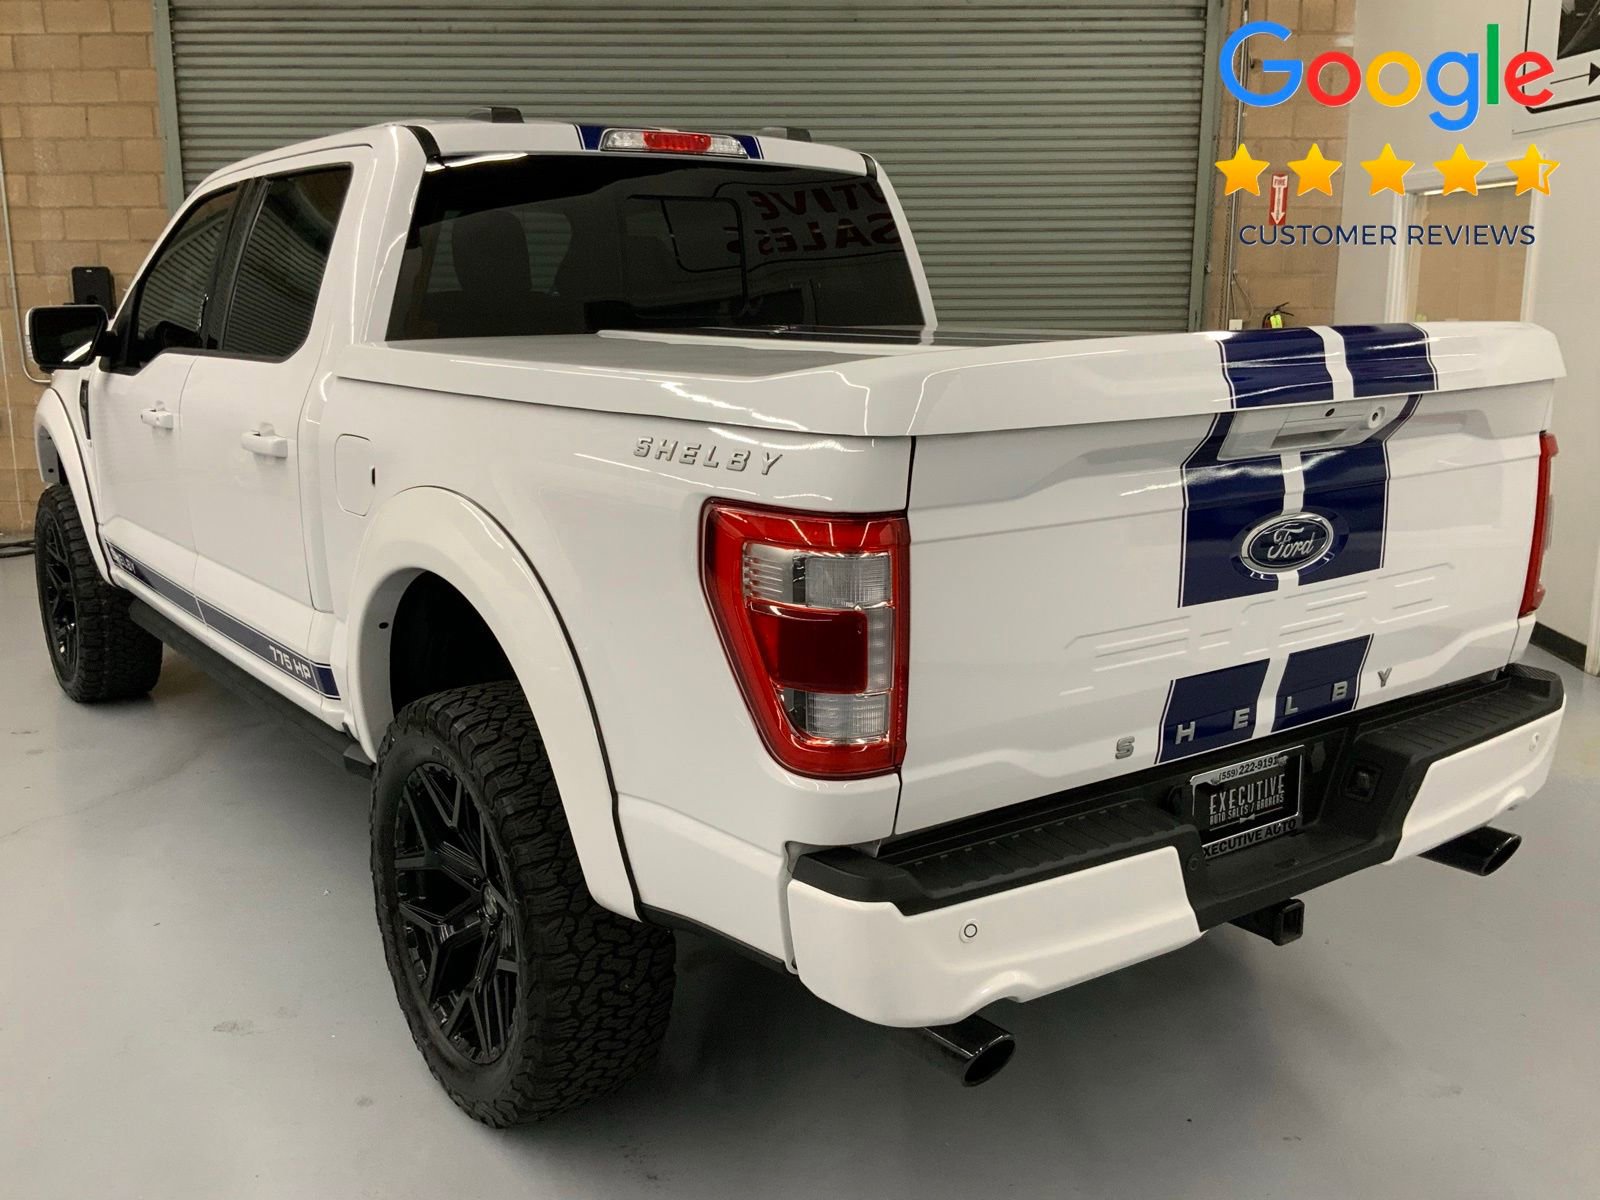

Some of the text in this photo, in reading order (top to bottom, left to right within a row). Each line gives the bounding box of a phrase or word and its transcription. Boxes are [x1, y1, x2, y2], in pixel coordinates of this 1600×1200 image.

[633, 436, 783, 476] SHELBY
[1264, 523, 1316, 560] Ford
[269, 645, 293, 670] 775
[1115, 667, 1393, 760] SHELBY
[1219, 756, 1278, 781] (559) 222-9191
[1209, 774, 1286, 815] EXECUTIVE
[1264, 819, 1297, 839] AUTO
